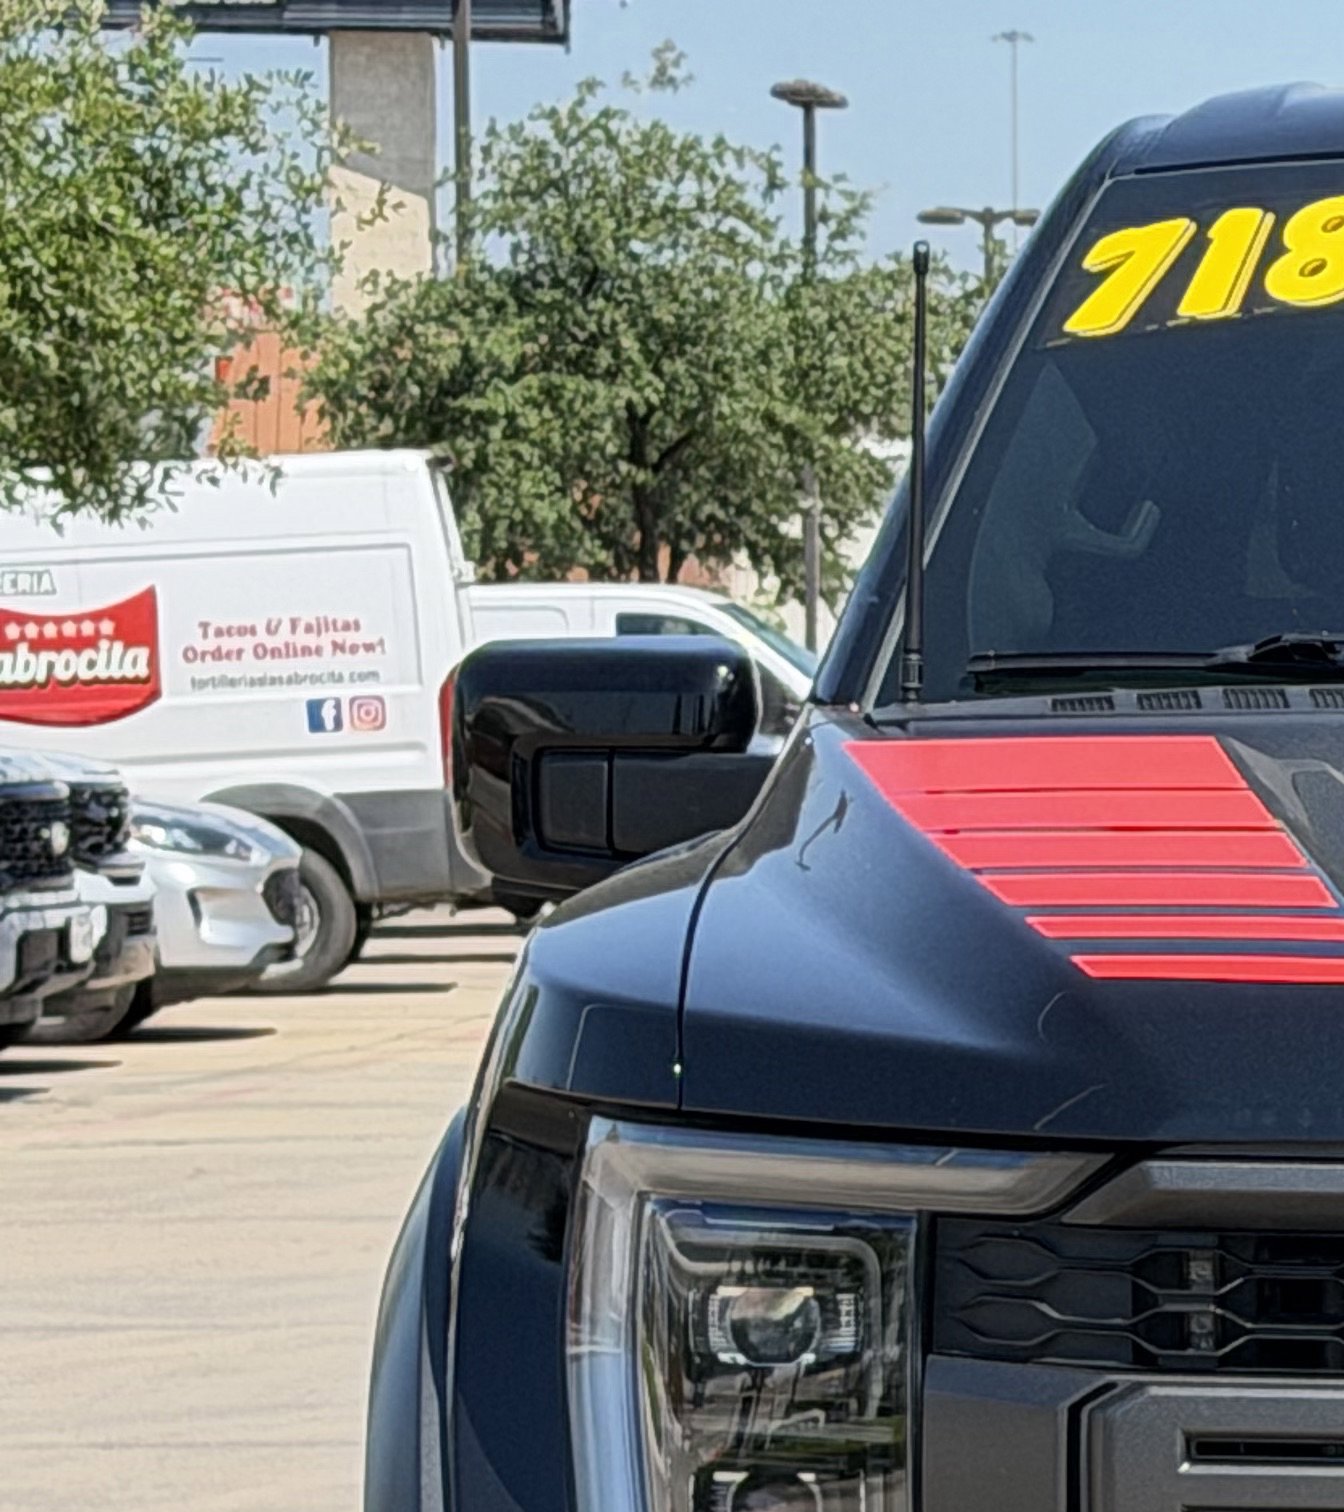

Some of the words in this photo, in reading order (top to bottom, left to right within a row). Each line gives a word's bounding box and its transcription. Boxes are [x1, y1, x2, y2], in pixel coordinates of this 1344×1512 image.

[198, 621, 257, 640] Tacos
[289, 615, 361, 637] Fajitas
[182, 645, 245, 664] Order
[252, 641, 324, 661] Online
[331, 636, 386, 657] Now!
